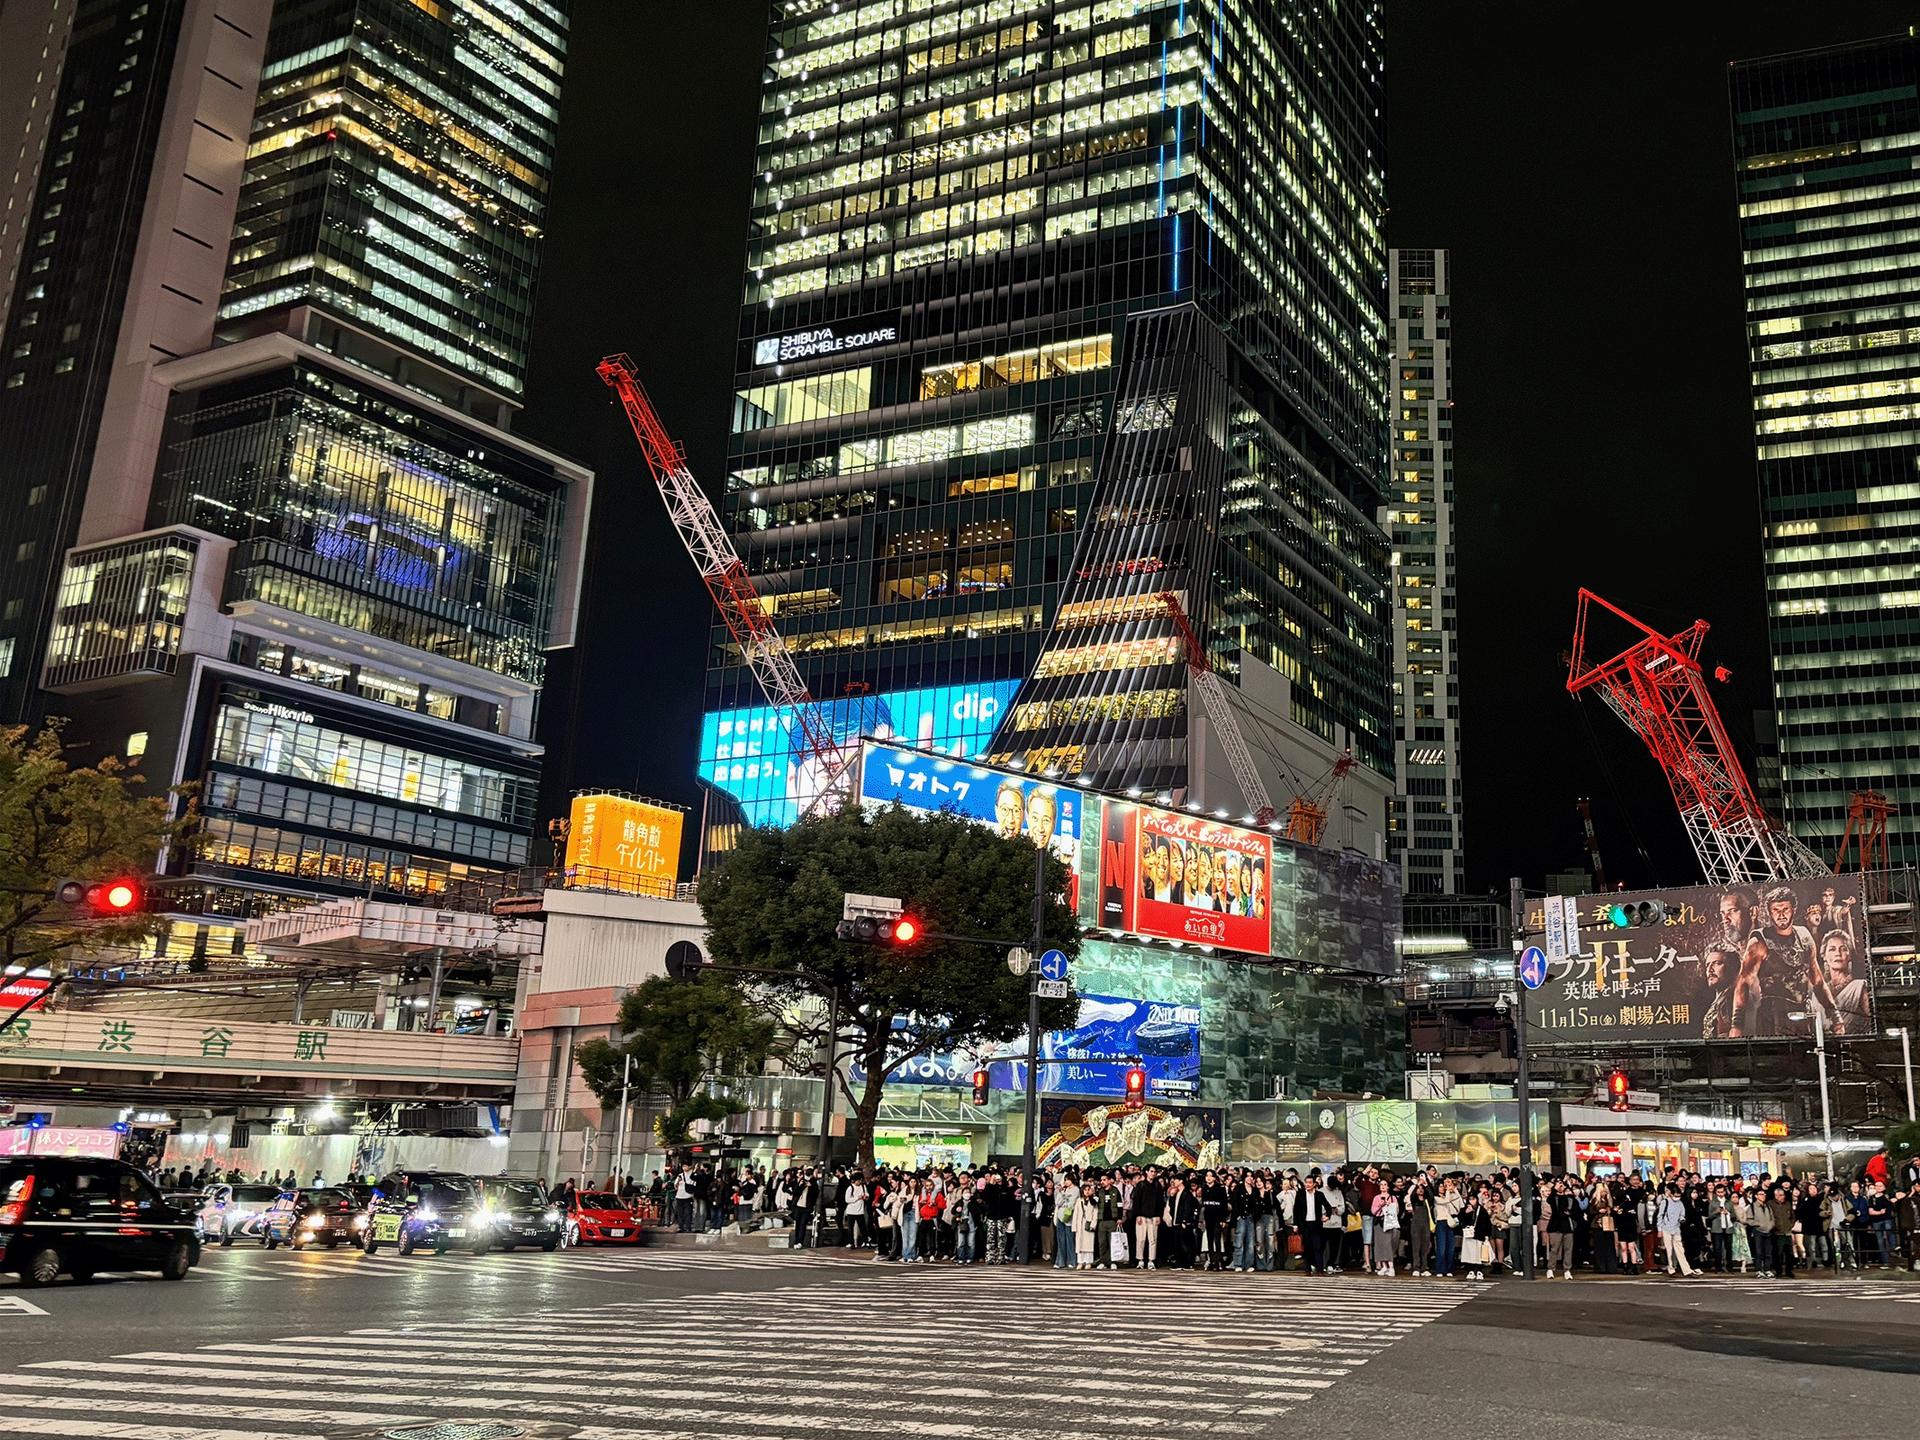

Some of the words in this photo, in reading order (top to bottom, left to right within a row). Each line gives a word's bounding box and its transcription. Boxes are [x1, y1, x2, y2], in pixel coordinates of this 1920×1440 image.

[780, 338, 843, 361] SCRAMBLE
[845, 328, 896, 348] SQUARE
[781, 328, 833, 348] SHIBUYA
[268, 703, 314, 724] Hikarie
[953, 692, 999, 722] dip
[908, 771, 970, 800] オトク
[623, 819, 661, 848] 龍角散
[1105, 840, 1125, 889] N
[1553, 945, 1699, 980] ラディエーター
[1562, 977, 1661, 1001] 英雄を呼ぶ声
[1619, 1004, 1690, 1026] 劇場公開
[38, 1132, 116, 1147] 体入ショコラ
